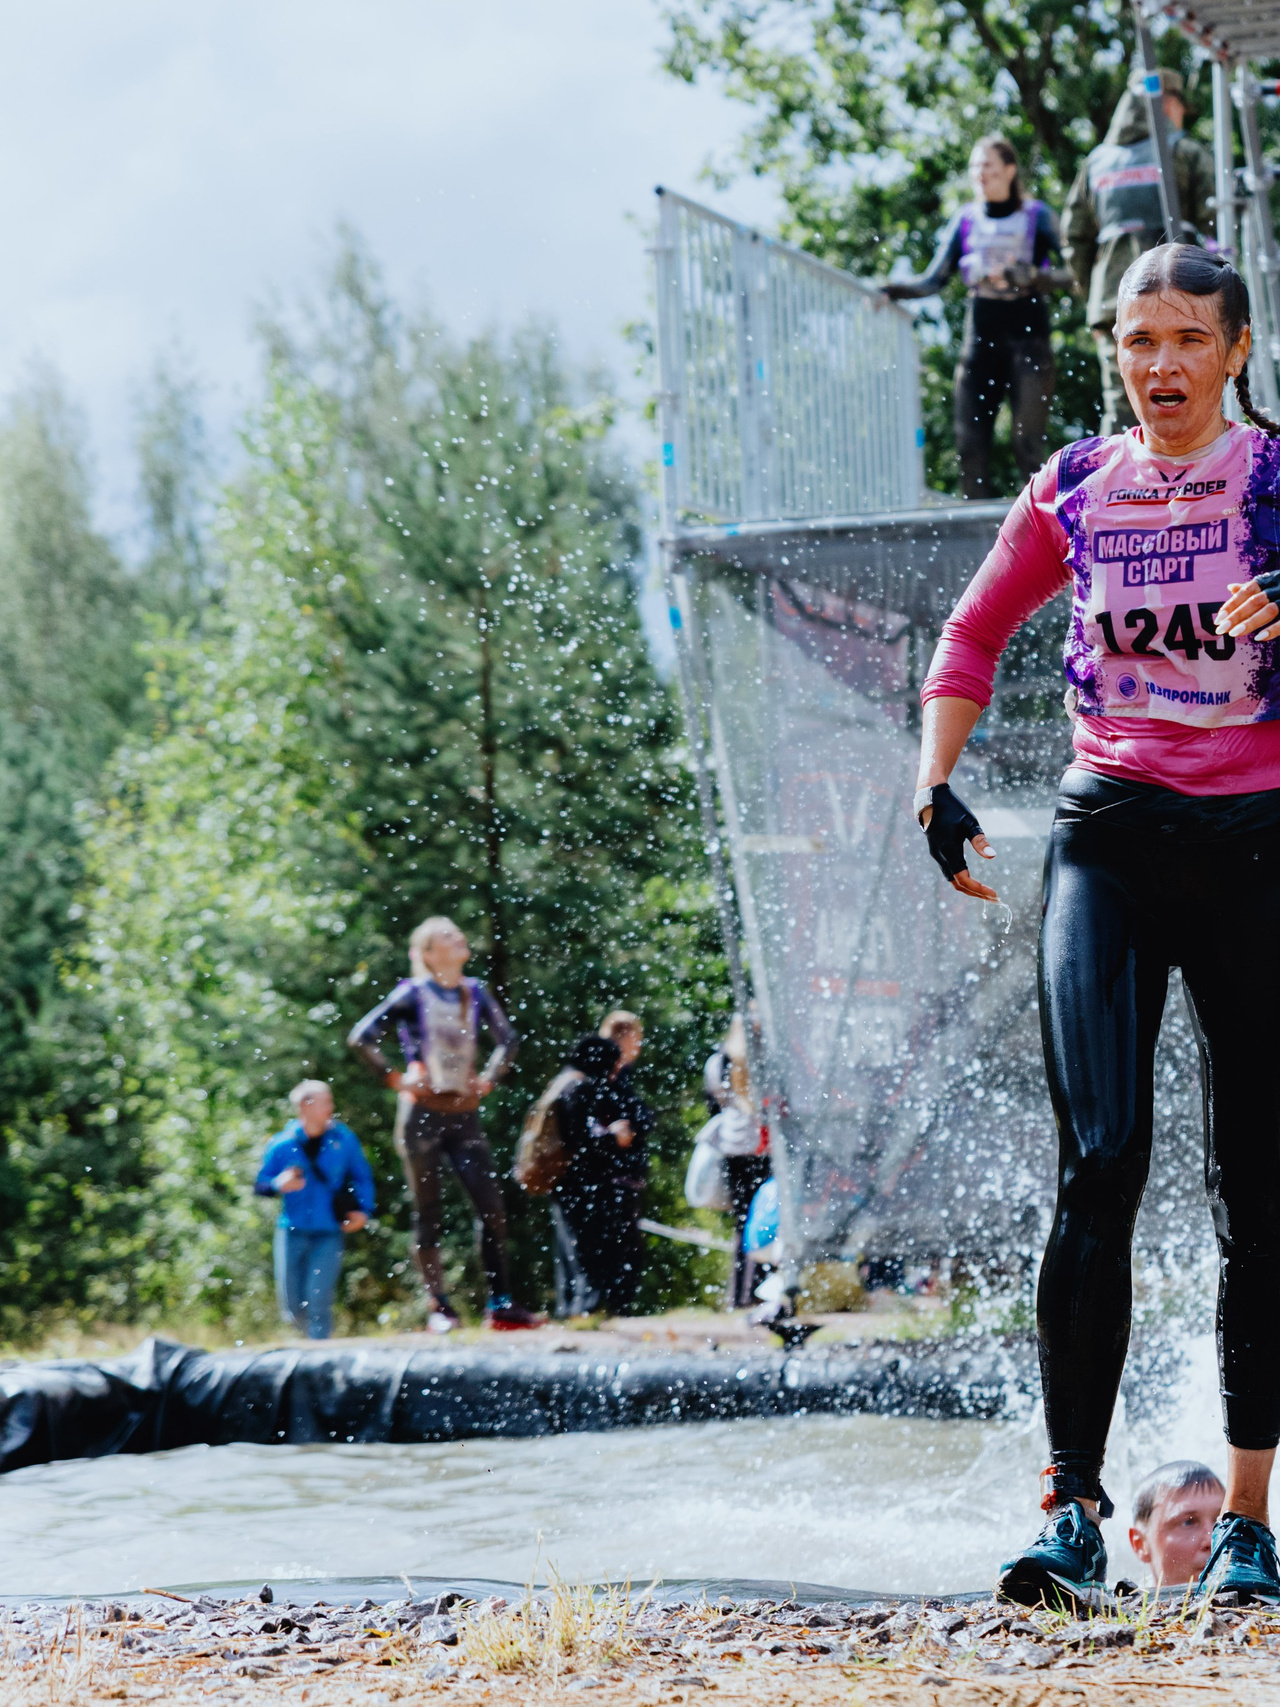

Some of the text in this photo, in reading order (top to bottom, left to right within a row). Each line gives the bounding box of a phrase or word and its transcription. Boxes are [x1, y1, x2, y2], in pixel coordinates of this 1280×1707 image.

[1107, 488, 1160, 503] ГОНКА
[1097, 519, 1222, 559] МАССОВЫЙ
[1127, 556, 1190, 584] СТАРТ
[1095, 601, 1236, 661] 1245
[1144, 681, 1231, 705] ГАЗПРОМБАНК
